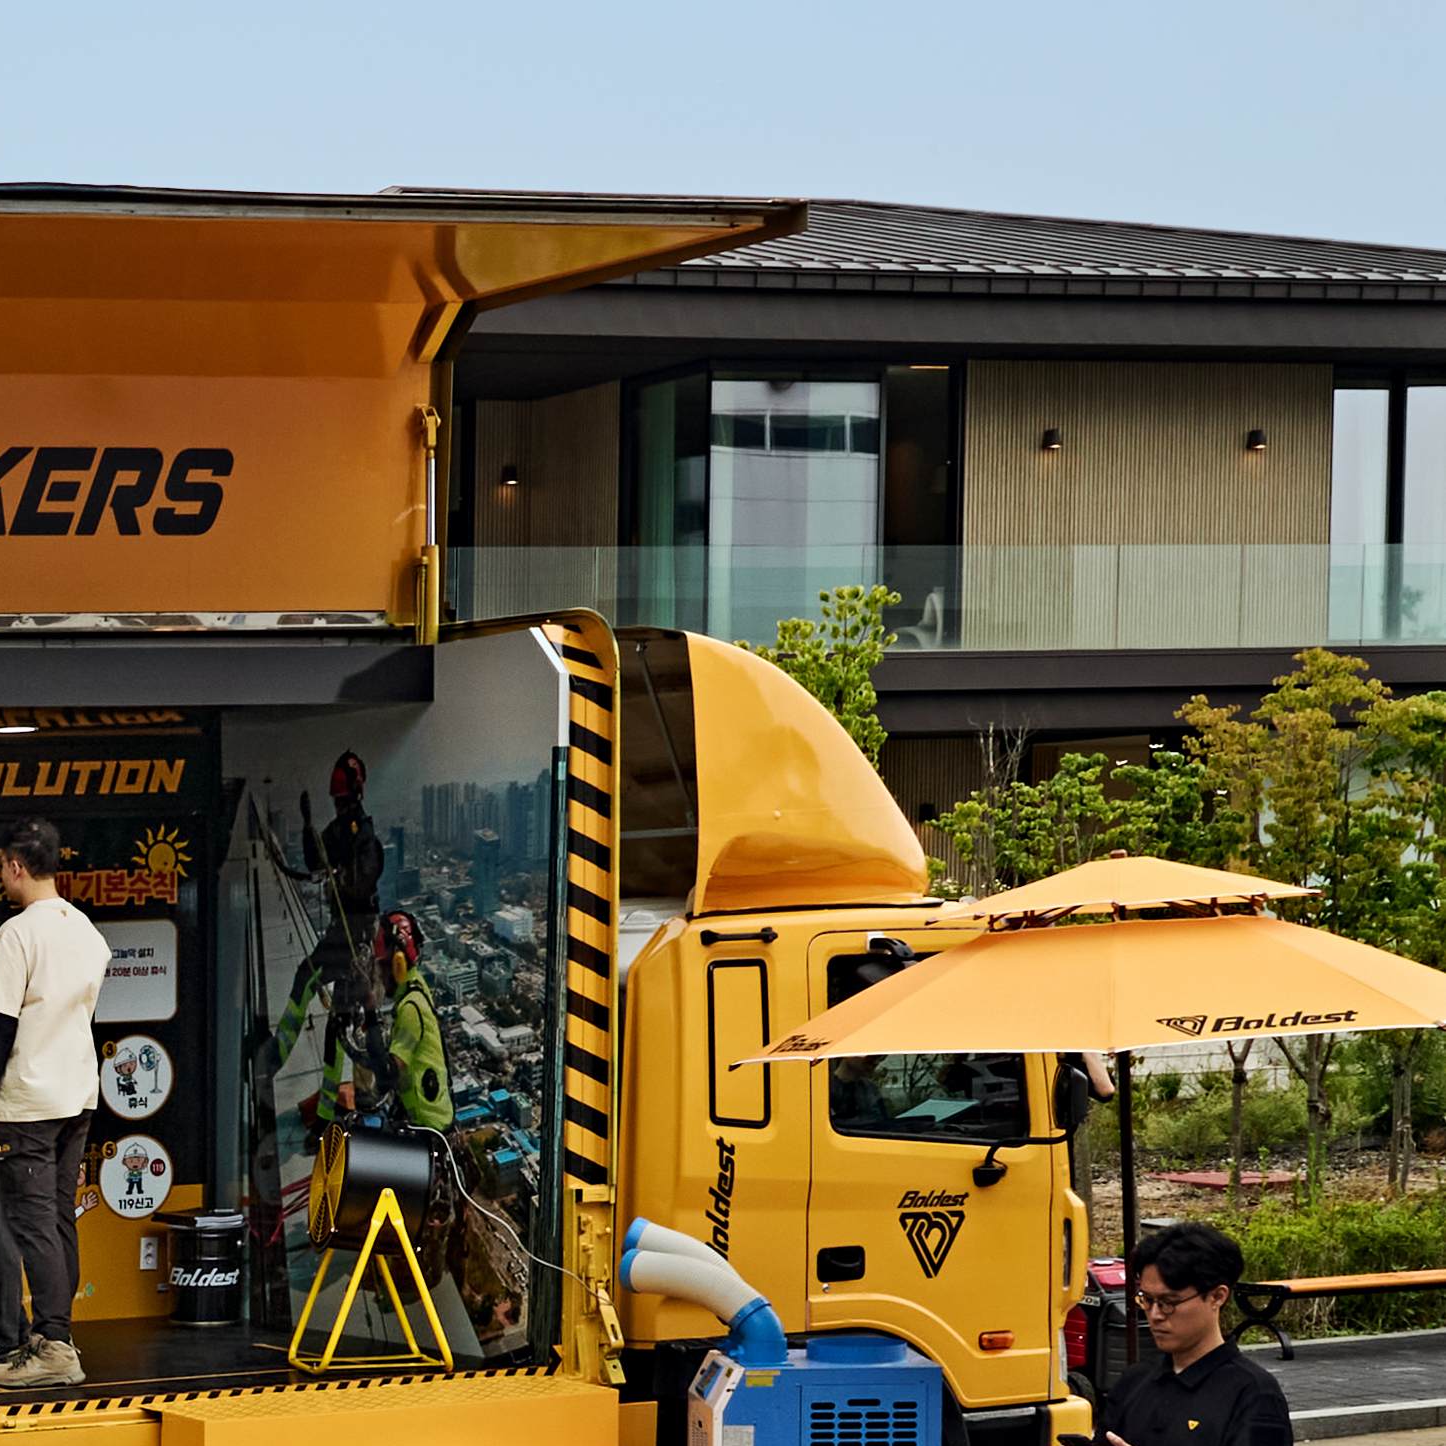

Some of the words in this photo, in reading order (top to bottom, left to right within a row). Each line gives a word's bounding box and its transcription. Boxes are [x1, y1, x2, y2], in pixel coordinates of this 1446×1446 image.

[77, 869, 179, 905] 기본수칙
[1211, 1010, 1358, 1033] Boldest
[128, 1096, 148, 1109] 휴식
[118, 1197, 154, 1210] 119신고
[897, 1190, 969, 1208] Boldest
[169, 1267, 240, 1287] Boldest
